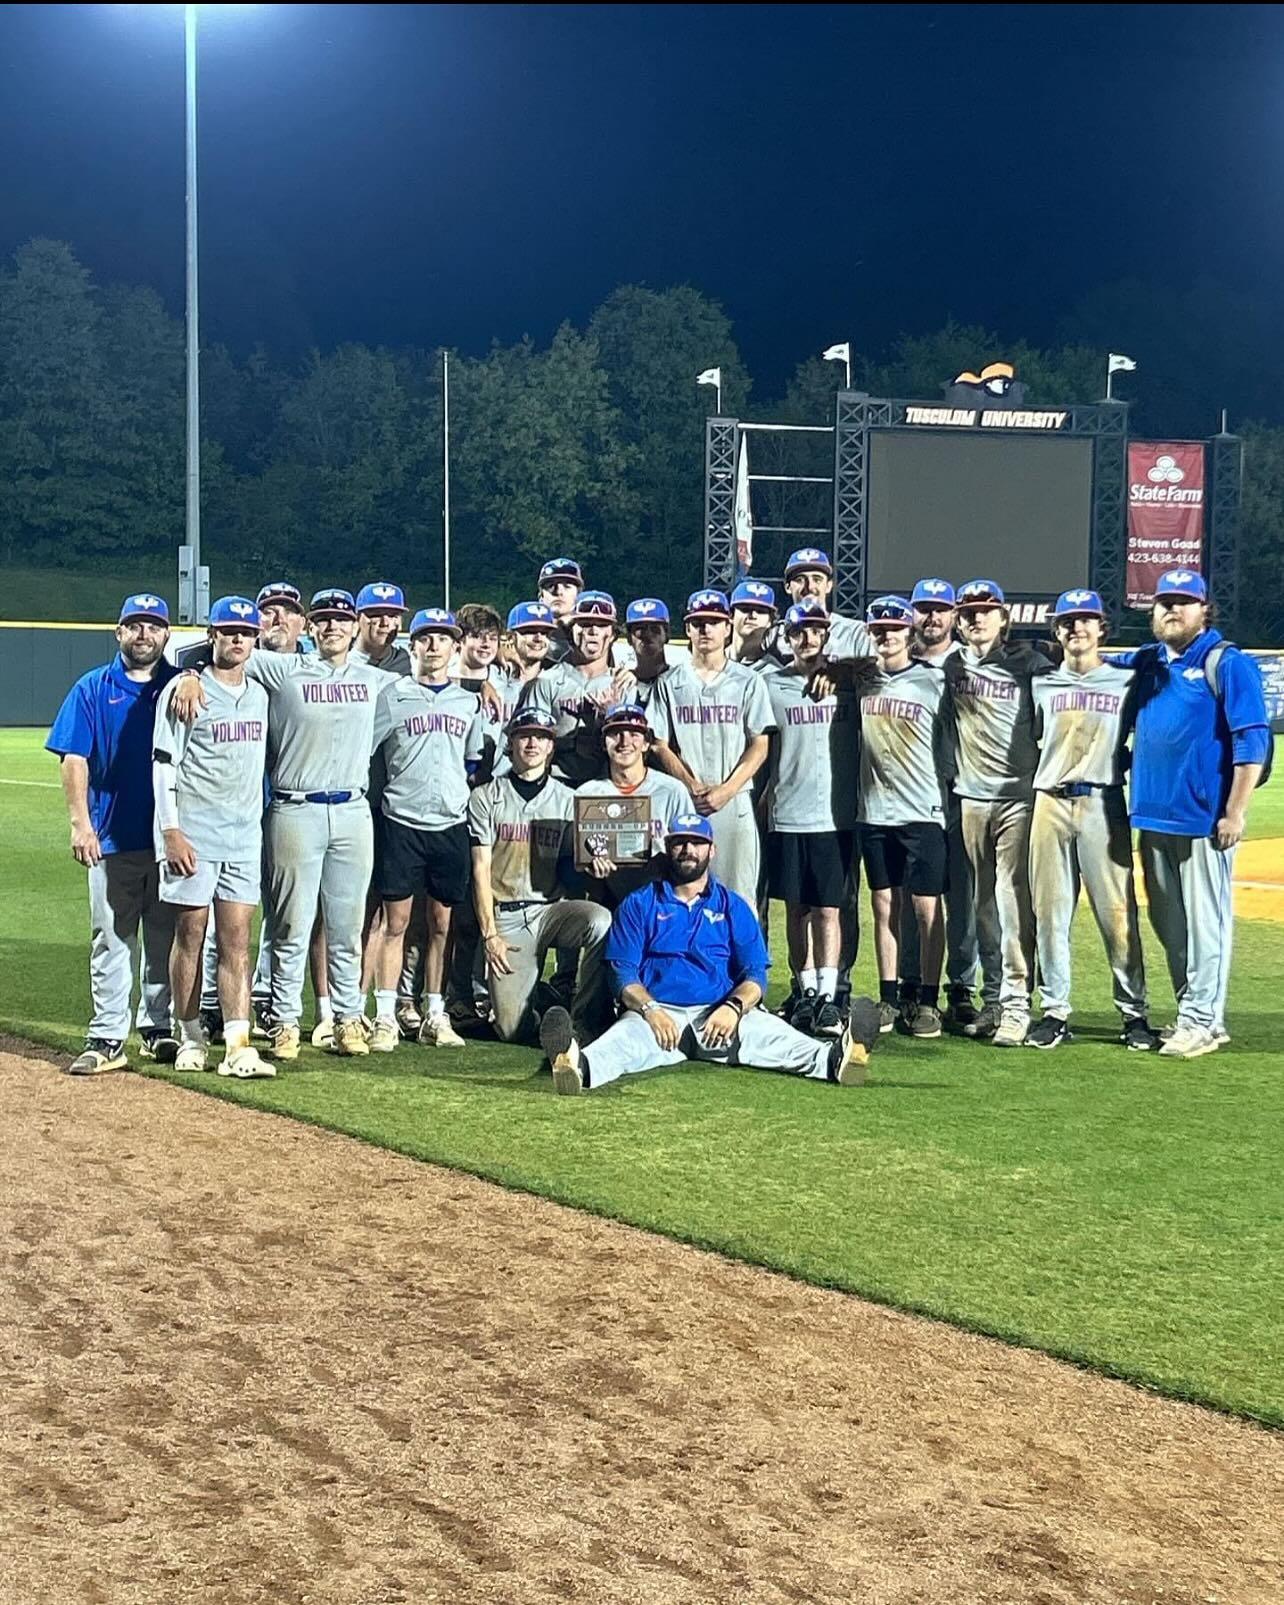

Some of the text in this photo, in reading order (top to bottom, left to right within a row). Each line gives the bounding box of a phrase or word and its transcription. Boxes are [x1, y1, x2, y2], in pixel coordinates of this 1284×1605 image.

[980, 410, 1066, 429] UNIVERSITY
[1128, 537, 1169, 549] Steven
[302, 684, 369, 704] VOLUNTEER
[1050, 691, 1120, 715] VOLUNTEER
[676, 705, 738, 724] VOLUNTEER
[212, 721, 263, 744] VOLUNTER
[404, 713, 467, 738] VOLUNTEER
